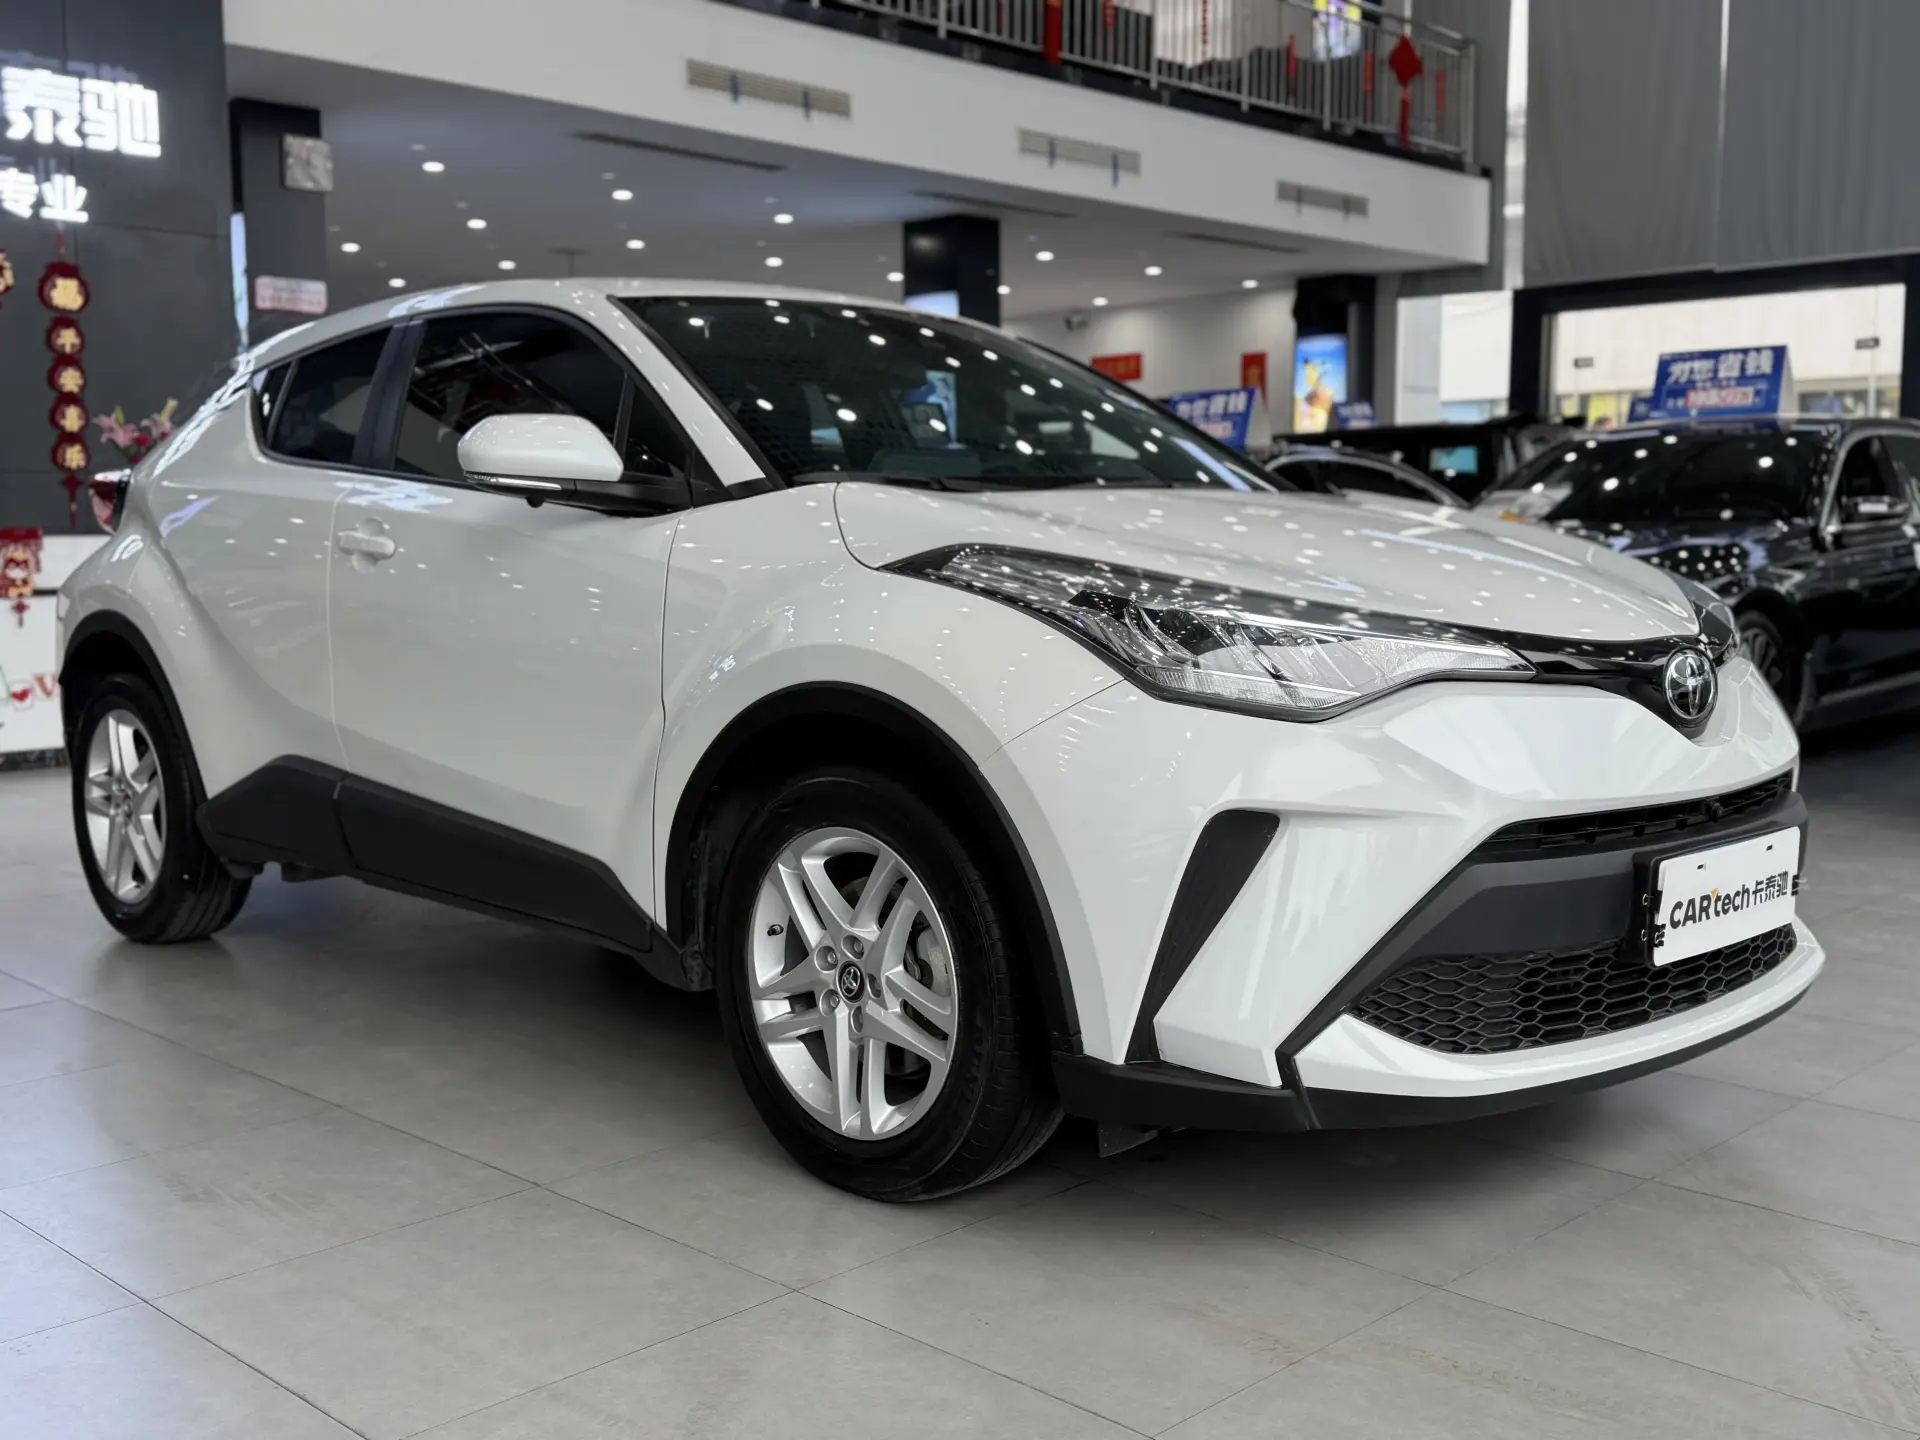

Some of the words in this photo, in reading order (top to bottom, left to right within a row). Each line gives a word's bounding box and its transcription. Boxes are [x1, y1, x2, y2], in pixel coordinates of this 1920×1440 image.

[1669, 883, 1750, 930] CARtech
[1752, 870, 1789, 906] 卡泰驰
